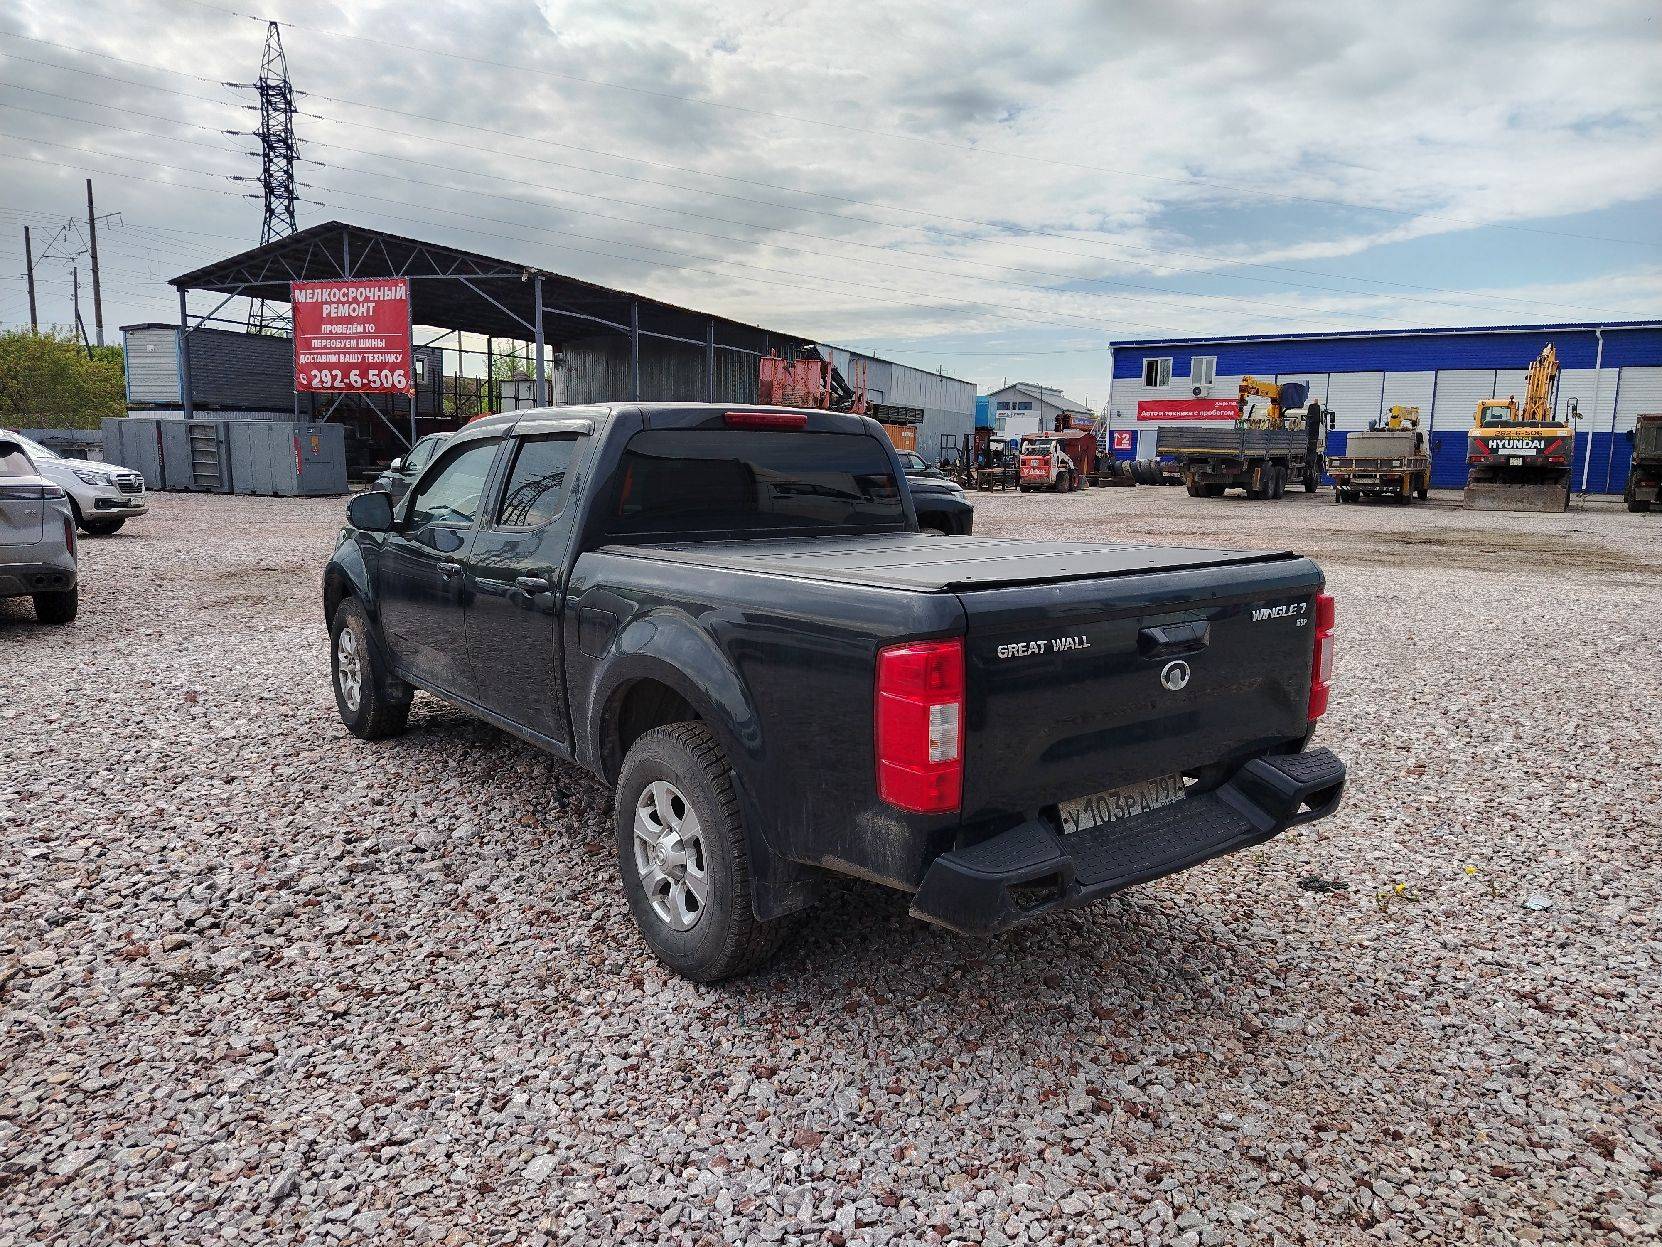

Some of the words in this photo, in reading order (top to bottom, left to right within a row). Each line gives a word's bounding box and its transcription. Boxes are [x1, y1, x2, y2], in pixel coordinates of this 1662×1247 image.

[295, 283, 406, 303] МЕЛКОСРОЧНЫЙ
[322, 303, 375, 317] РЕМОНТ
[321, 323, 364, 334] ПРОВЕДЁМ
[364, 324, 375, 332] ТО
[311, 339, 357, 348] ПЕРЕОБУЕМ
[358, 338, 386, 347] ШИНЫ
[300, 354, 339, 363] ДОСТАВИМ
[339, 354, 363, 363] ВАШУ
[364, 353, 403, 362] ТЕХНИКУ
[311, 369, 407, 389] 292-6-506
[1121, 433, 1130, 444] 2
[1488, 440, 1545, 449] HYUNDAI
[1252, 603, 1298, 621] WINGLE
[1299, 602, 1307, 613] 7
[997, 640, 1048, 658] GREAT
[1051, 635, 1091, 652] WALL
